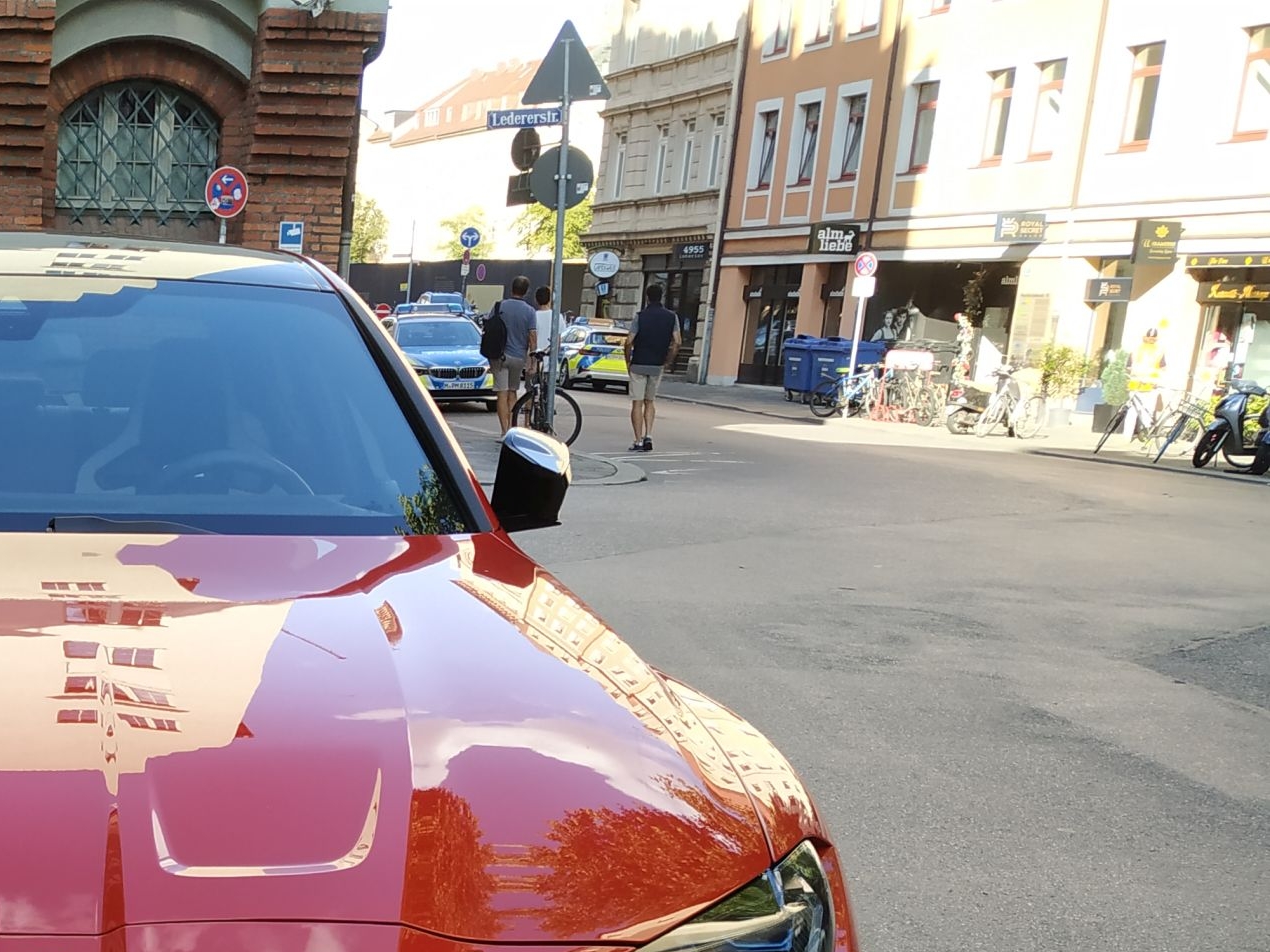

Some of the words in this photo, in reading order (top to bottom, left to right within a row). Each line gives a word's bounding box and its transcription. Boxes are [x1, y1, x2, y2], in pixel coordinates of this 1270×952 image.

[491, 110, 559, 127] Ledererstr.
[818, 226, 844, 240] alm
[683, 245, 705, 254] 4955
[819, 239, 853, 252] liebe
